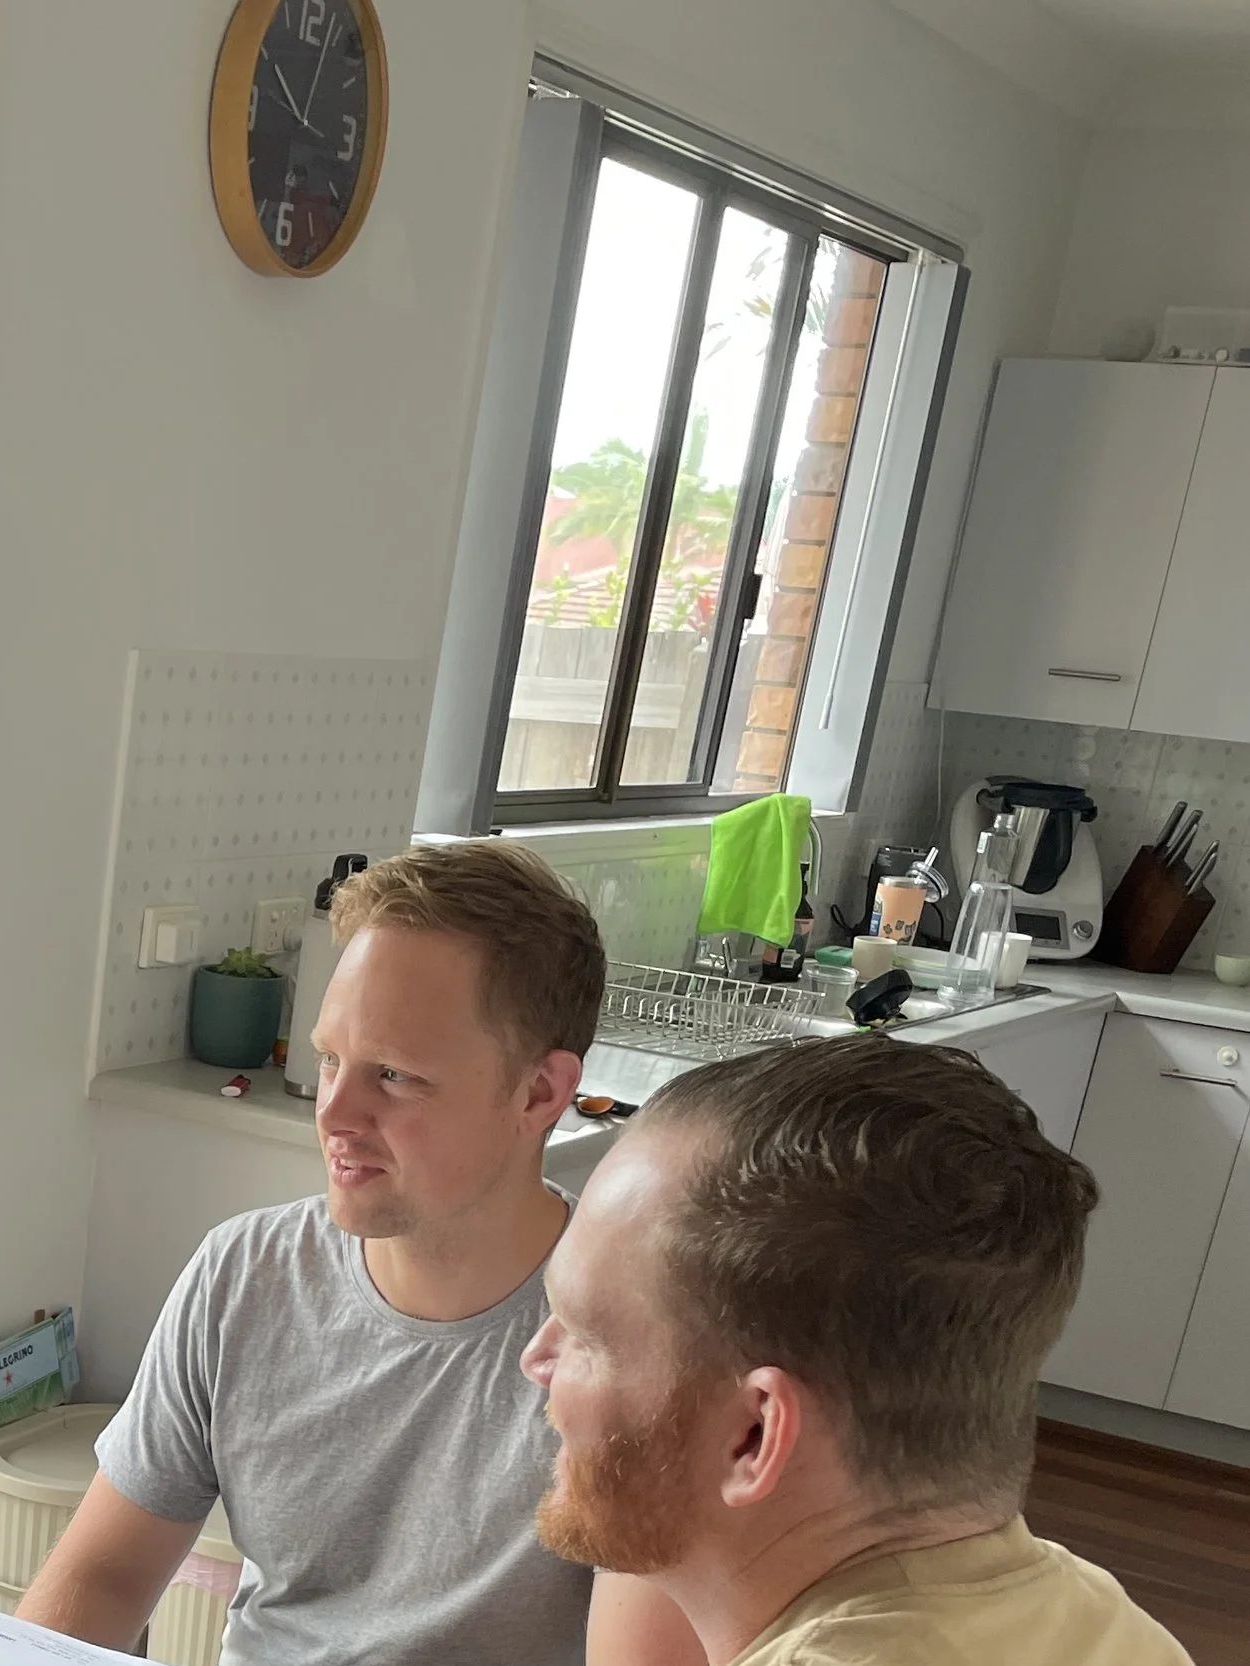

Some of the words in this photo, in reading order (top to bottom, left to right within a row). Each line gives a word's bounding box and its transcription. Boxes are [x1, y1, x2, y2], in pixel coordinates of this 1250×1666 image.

[299, 0, 325, 46] 12
[337, 114, 357, 161] 3
[275, 201, 294, 247] 6
